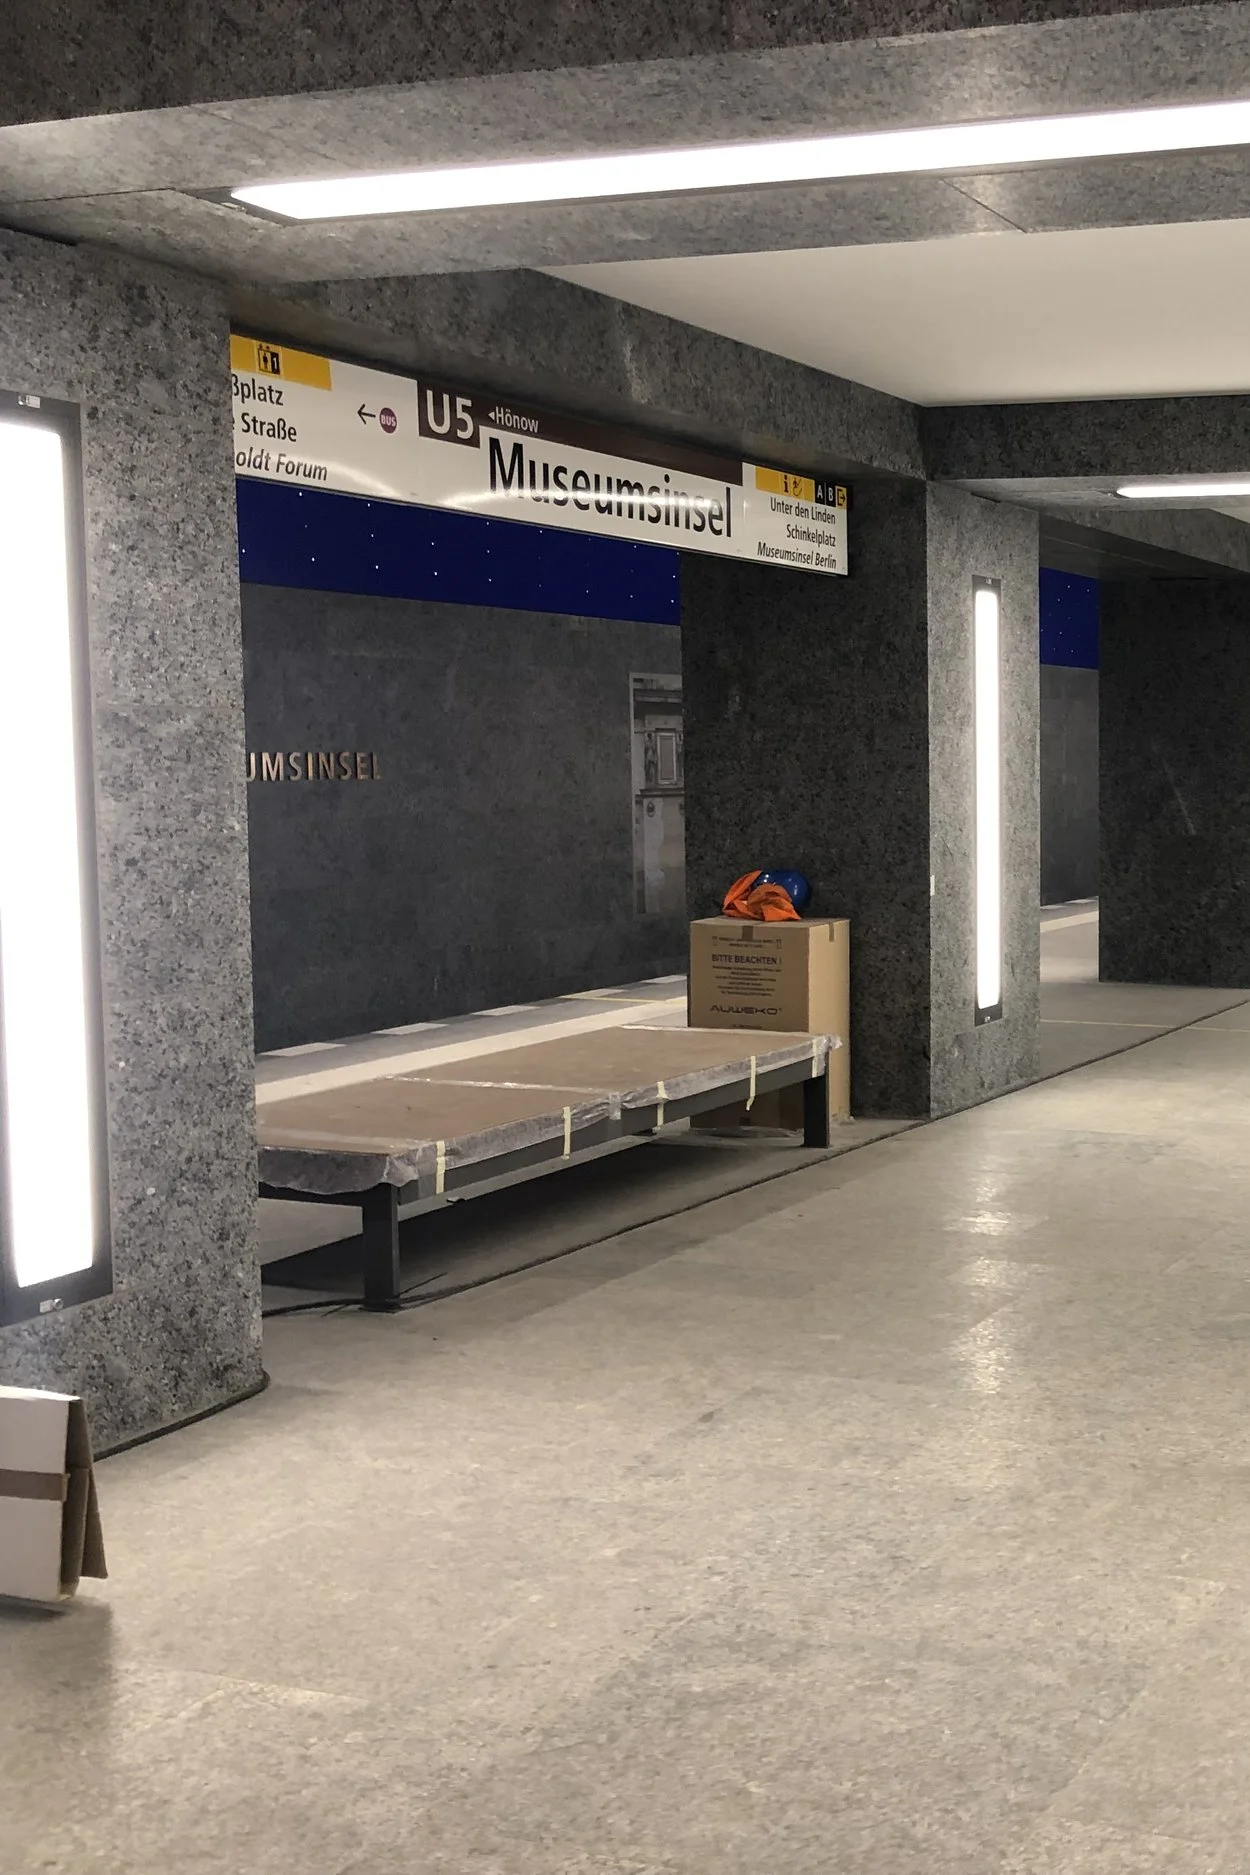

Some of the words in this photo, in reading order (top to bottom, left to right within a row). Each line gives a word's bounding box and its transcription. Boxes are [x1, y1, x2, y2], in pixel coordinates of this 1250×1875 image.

[241, 412, 297, 442] Straße
[380, 414, 397, 427] BUS
[426, 389, 475, 440] U5
[495, 406, 540, 433] Hönow
[236, 447, 272, 472] oldt
[276, 453, 328, 481] Forum
[489, 436, 732, 538] Museumsinsel
[816, 485, 823, 499] A
[828, 487, 834, 501] B
[770, 497, 793, 515] Unter
[794, 502, 810, 519] den
[811, 506, 836, 524] Linden
[786, 524, 836, 547] Schinkelplatz
[757, 541, 814, 564] Museumsinsel
[815, 552, 836, 569] Berlin
[711, 954, 733, 962] BITTE
[734, 955, 777, 964] BEACHTEN
